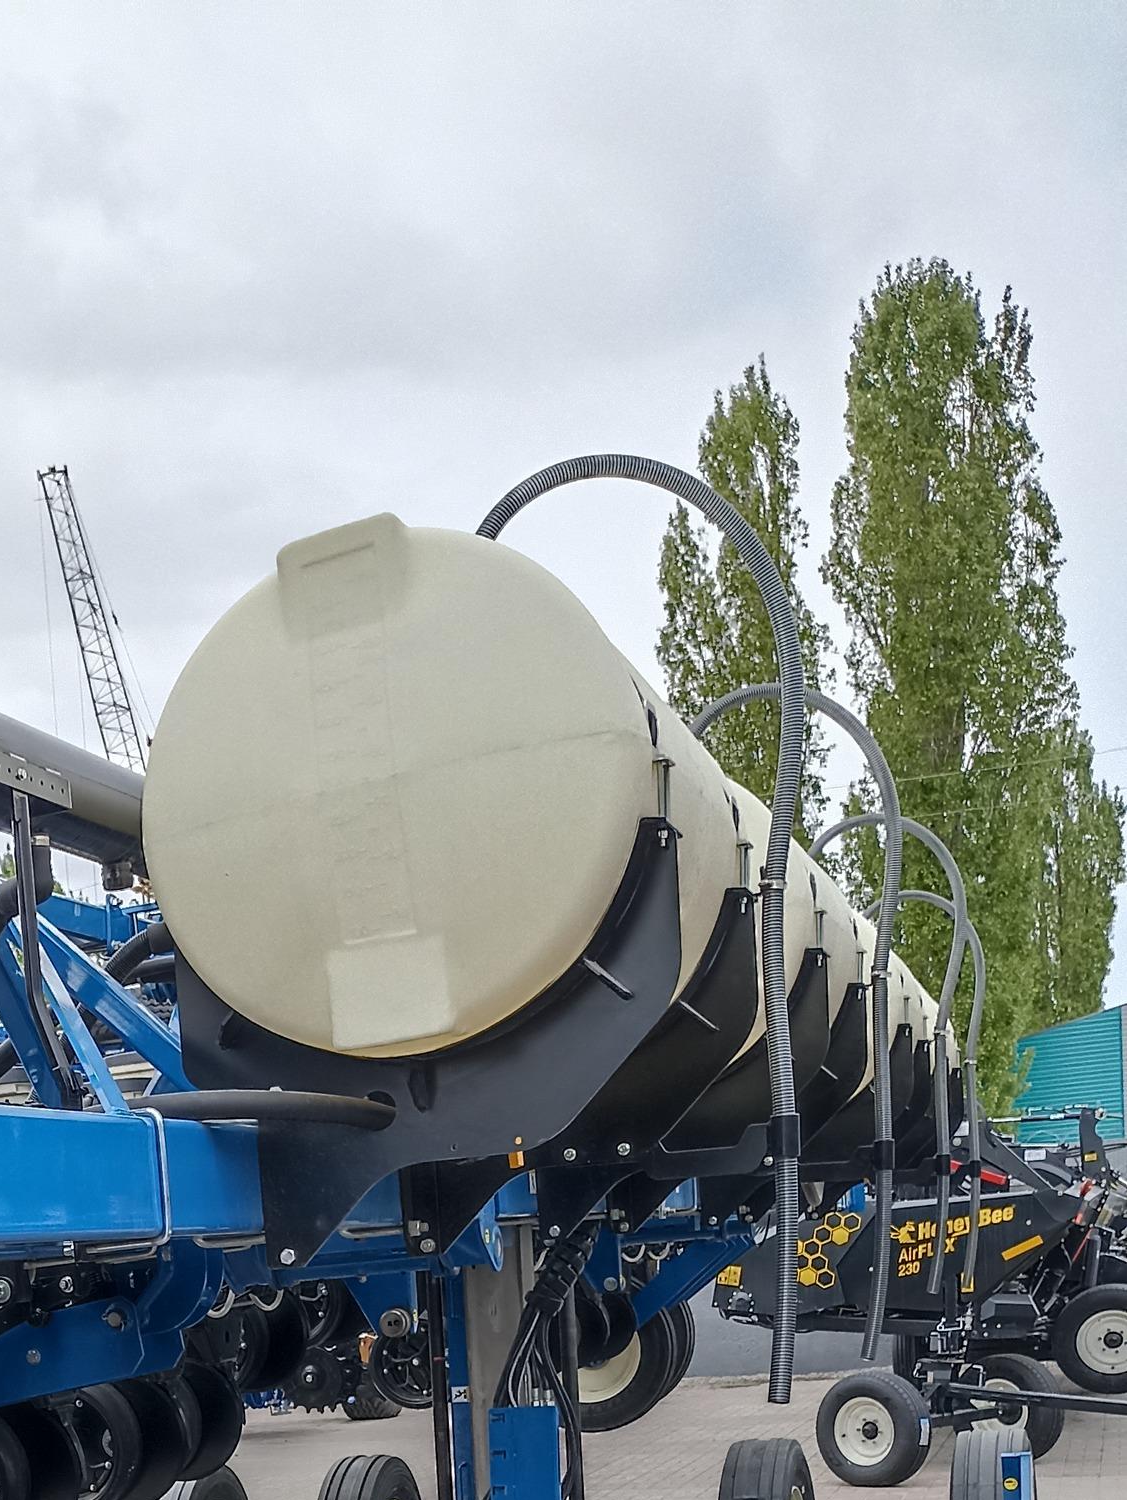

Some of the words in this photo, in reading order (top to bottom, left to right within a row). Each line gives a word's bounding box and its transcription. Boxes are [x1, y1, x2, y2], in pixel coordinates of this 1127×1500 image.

[978, 1206, 1014, 1228] Bee
[898, 1237, 955, 1263] AirFLX
[898, 1261, 921, 1277] 230
